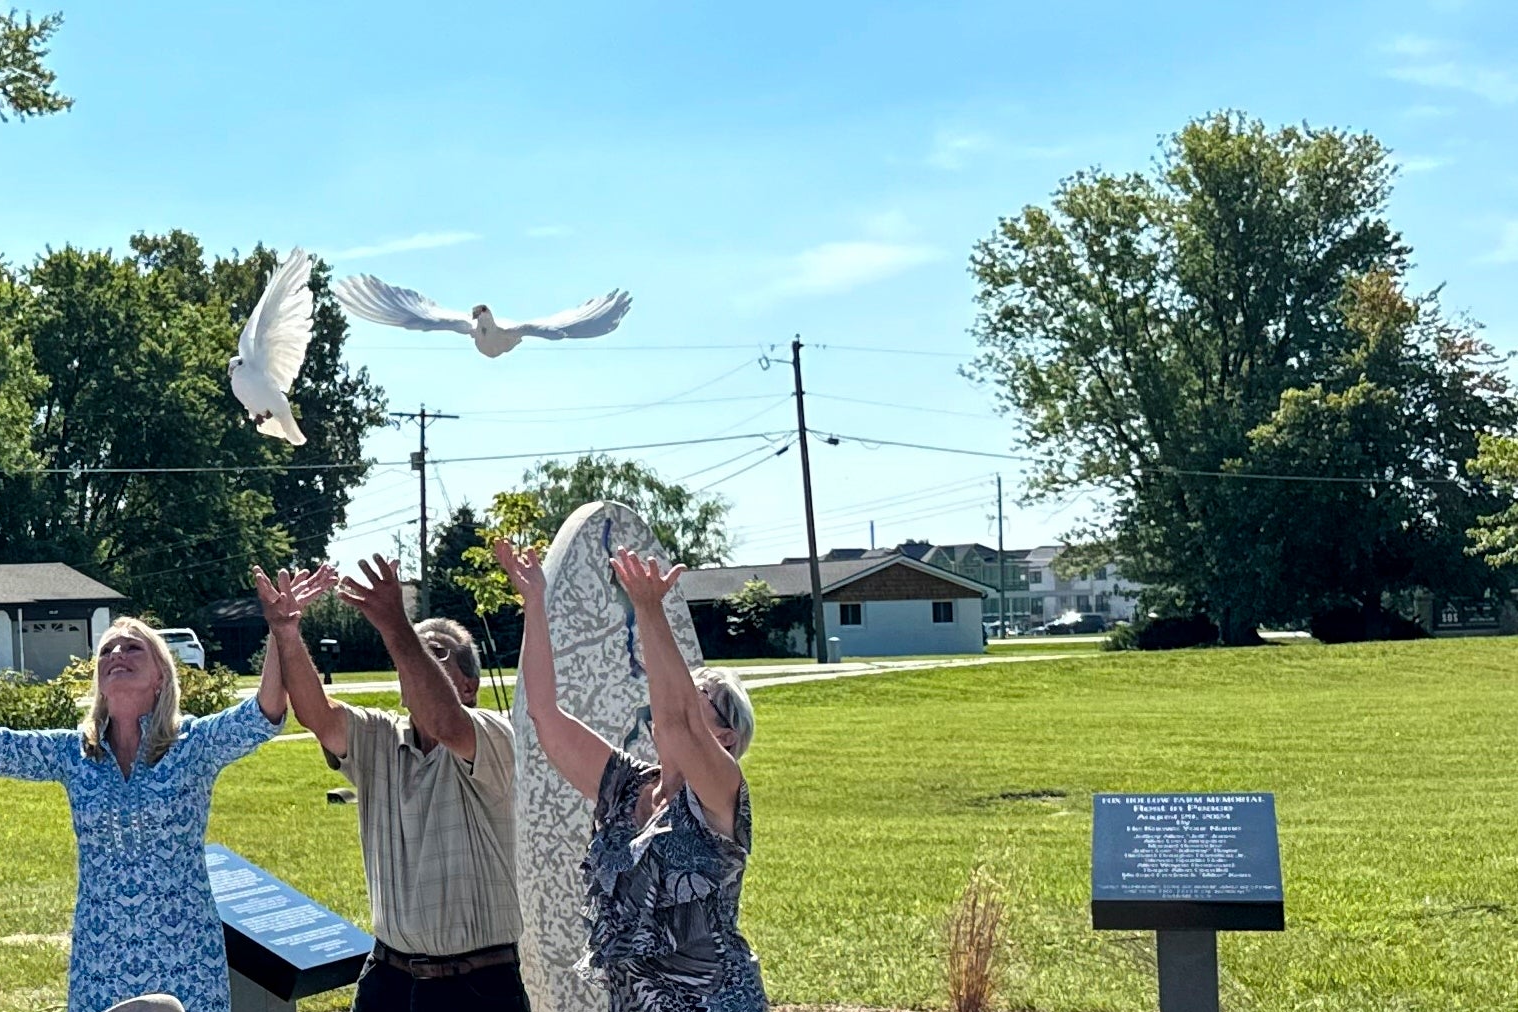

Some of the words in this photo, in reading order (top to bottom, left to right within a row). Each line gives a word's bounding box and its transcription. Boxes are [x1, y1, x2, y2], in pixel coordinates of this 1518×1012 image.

[1101, 796, 1122, 804] FOX
[1125, 796, 1170, 804] HOLLOW
[1173, 796, 1202, 804] FARM
[1206, 795, 1265, 803] MEMORIAL
[1132, 804, 1166, 812] Rest
[1186, 804, 1234, 812] Peace
[1136, 813, 1179, 821] August
